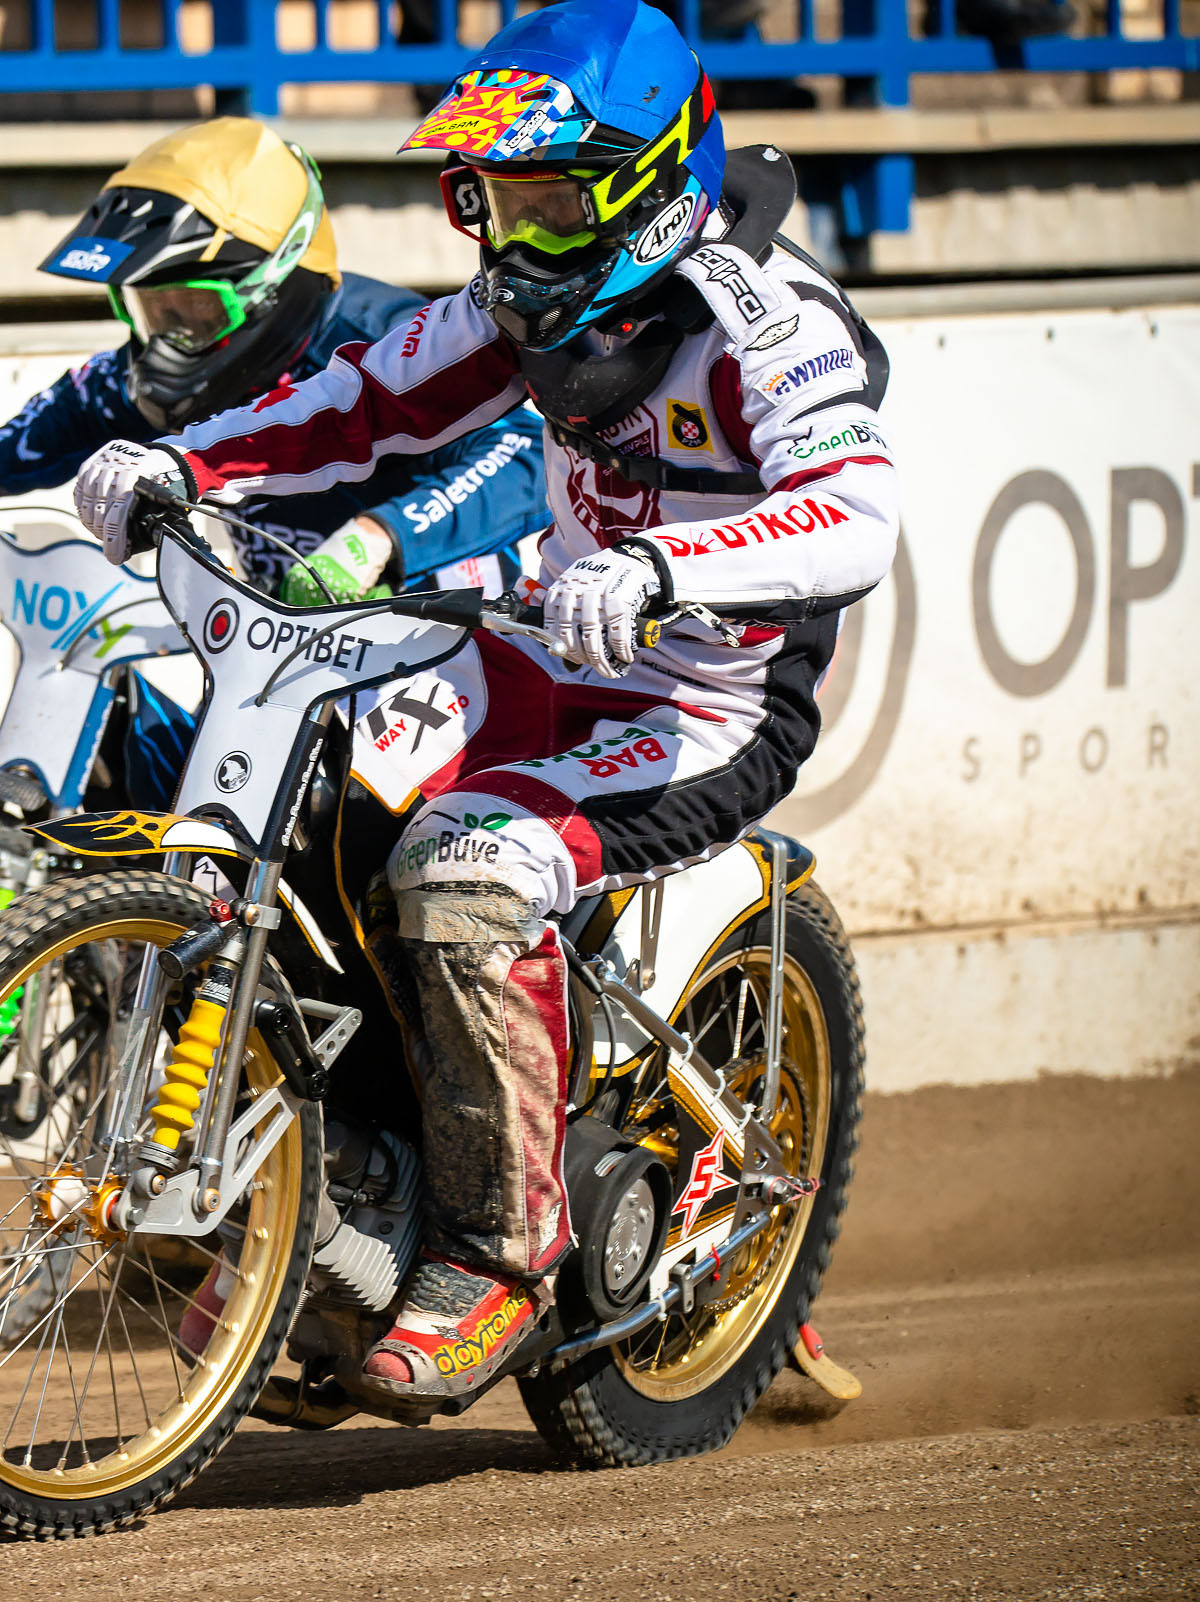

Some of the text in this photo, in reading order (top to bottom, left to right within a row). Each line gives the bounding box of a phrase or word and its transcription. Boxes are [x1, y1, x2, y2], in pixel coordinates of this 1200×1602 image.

[574, 560, 611, 574] Wulf
[971, 464, 1200, 700] OP
[246, 616, 373, 672] OPTIBET
[447, 694, 470, 716] TO
[374, 718, 408, 753] WAY
[577, 737, 668, 778] BAR
